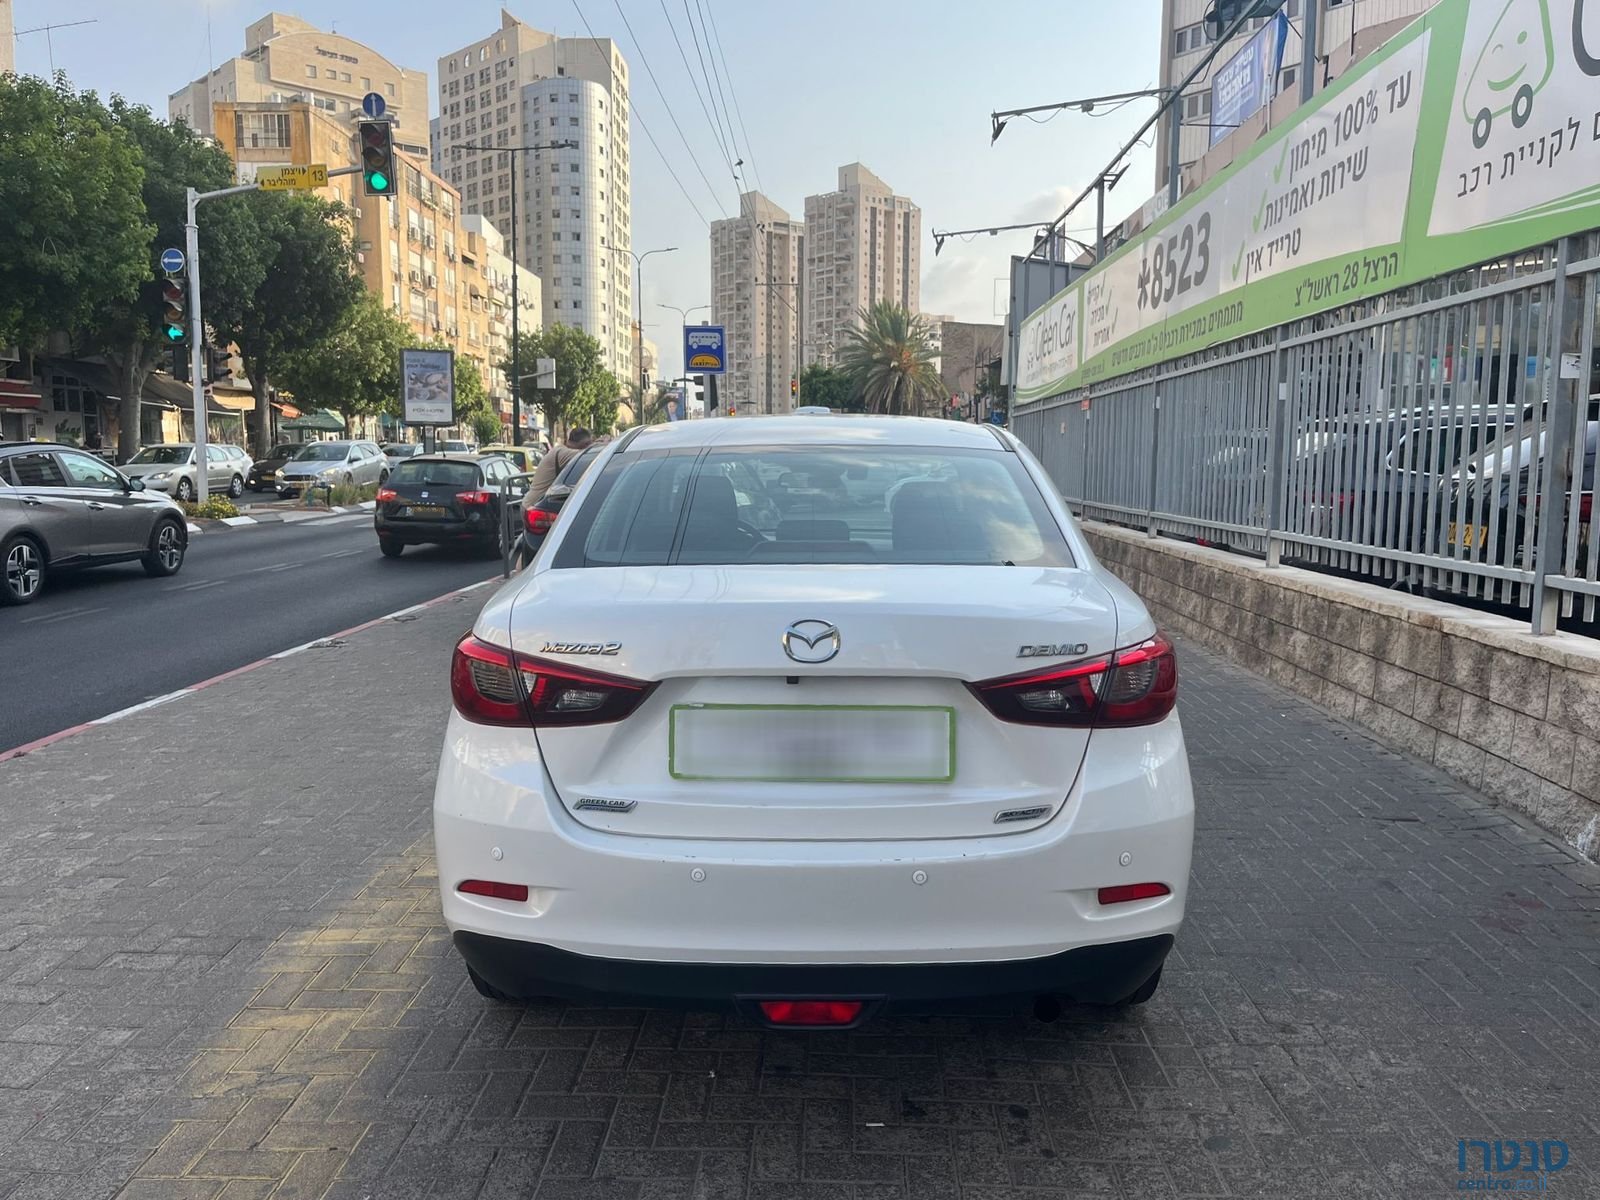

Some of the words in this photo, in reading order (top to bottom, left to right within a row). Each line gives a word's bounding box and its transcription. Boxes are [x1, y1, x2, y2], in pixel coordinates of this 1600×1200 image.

[1387, 71, 1412, 113] עד
[1334, 89, 1378, 147] 100%
[1289, 127, 1327, 184] מימון
[1501, 117, 1581, 179] לקניית
[281, 167, 301, 177] ויצמן
[312, 169, 324, 182] 13
[1318, 146, 1368, 202] שירות
[1457, 162, 1492, 198] רכב
[1264, 177, 1315, 231] ואמינות
[1246, 245, 1264, 285] אין
[1267, 227, 1301, 267] טרייד
[1343, 261, 1359, 291] 28
[1363, 251, 1398, 285] הרצל
[1179, 317, 1207, 345] במכירת
[1208, 300, 1243, 333] מתמחים
[1016, 643, 1088, 658] DEMIO
